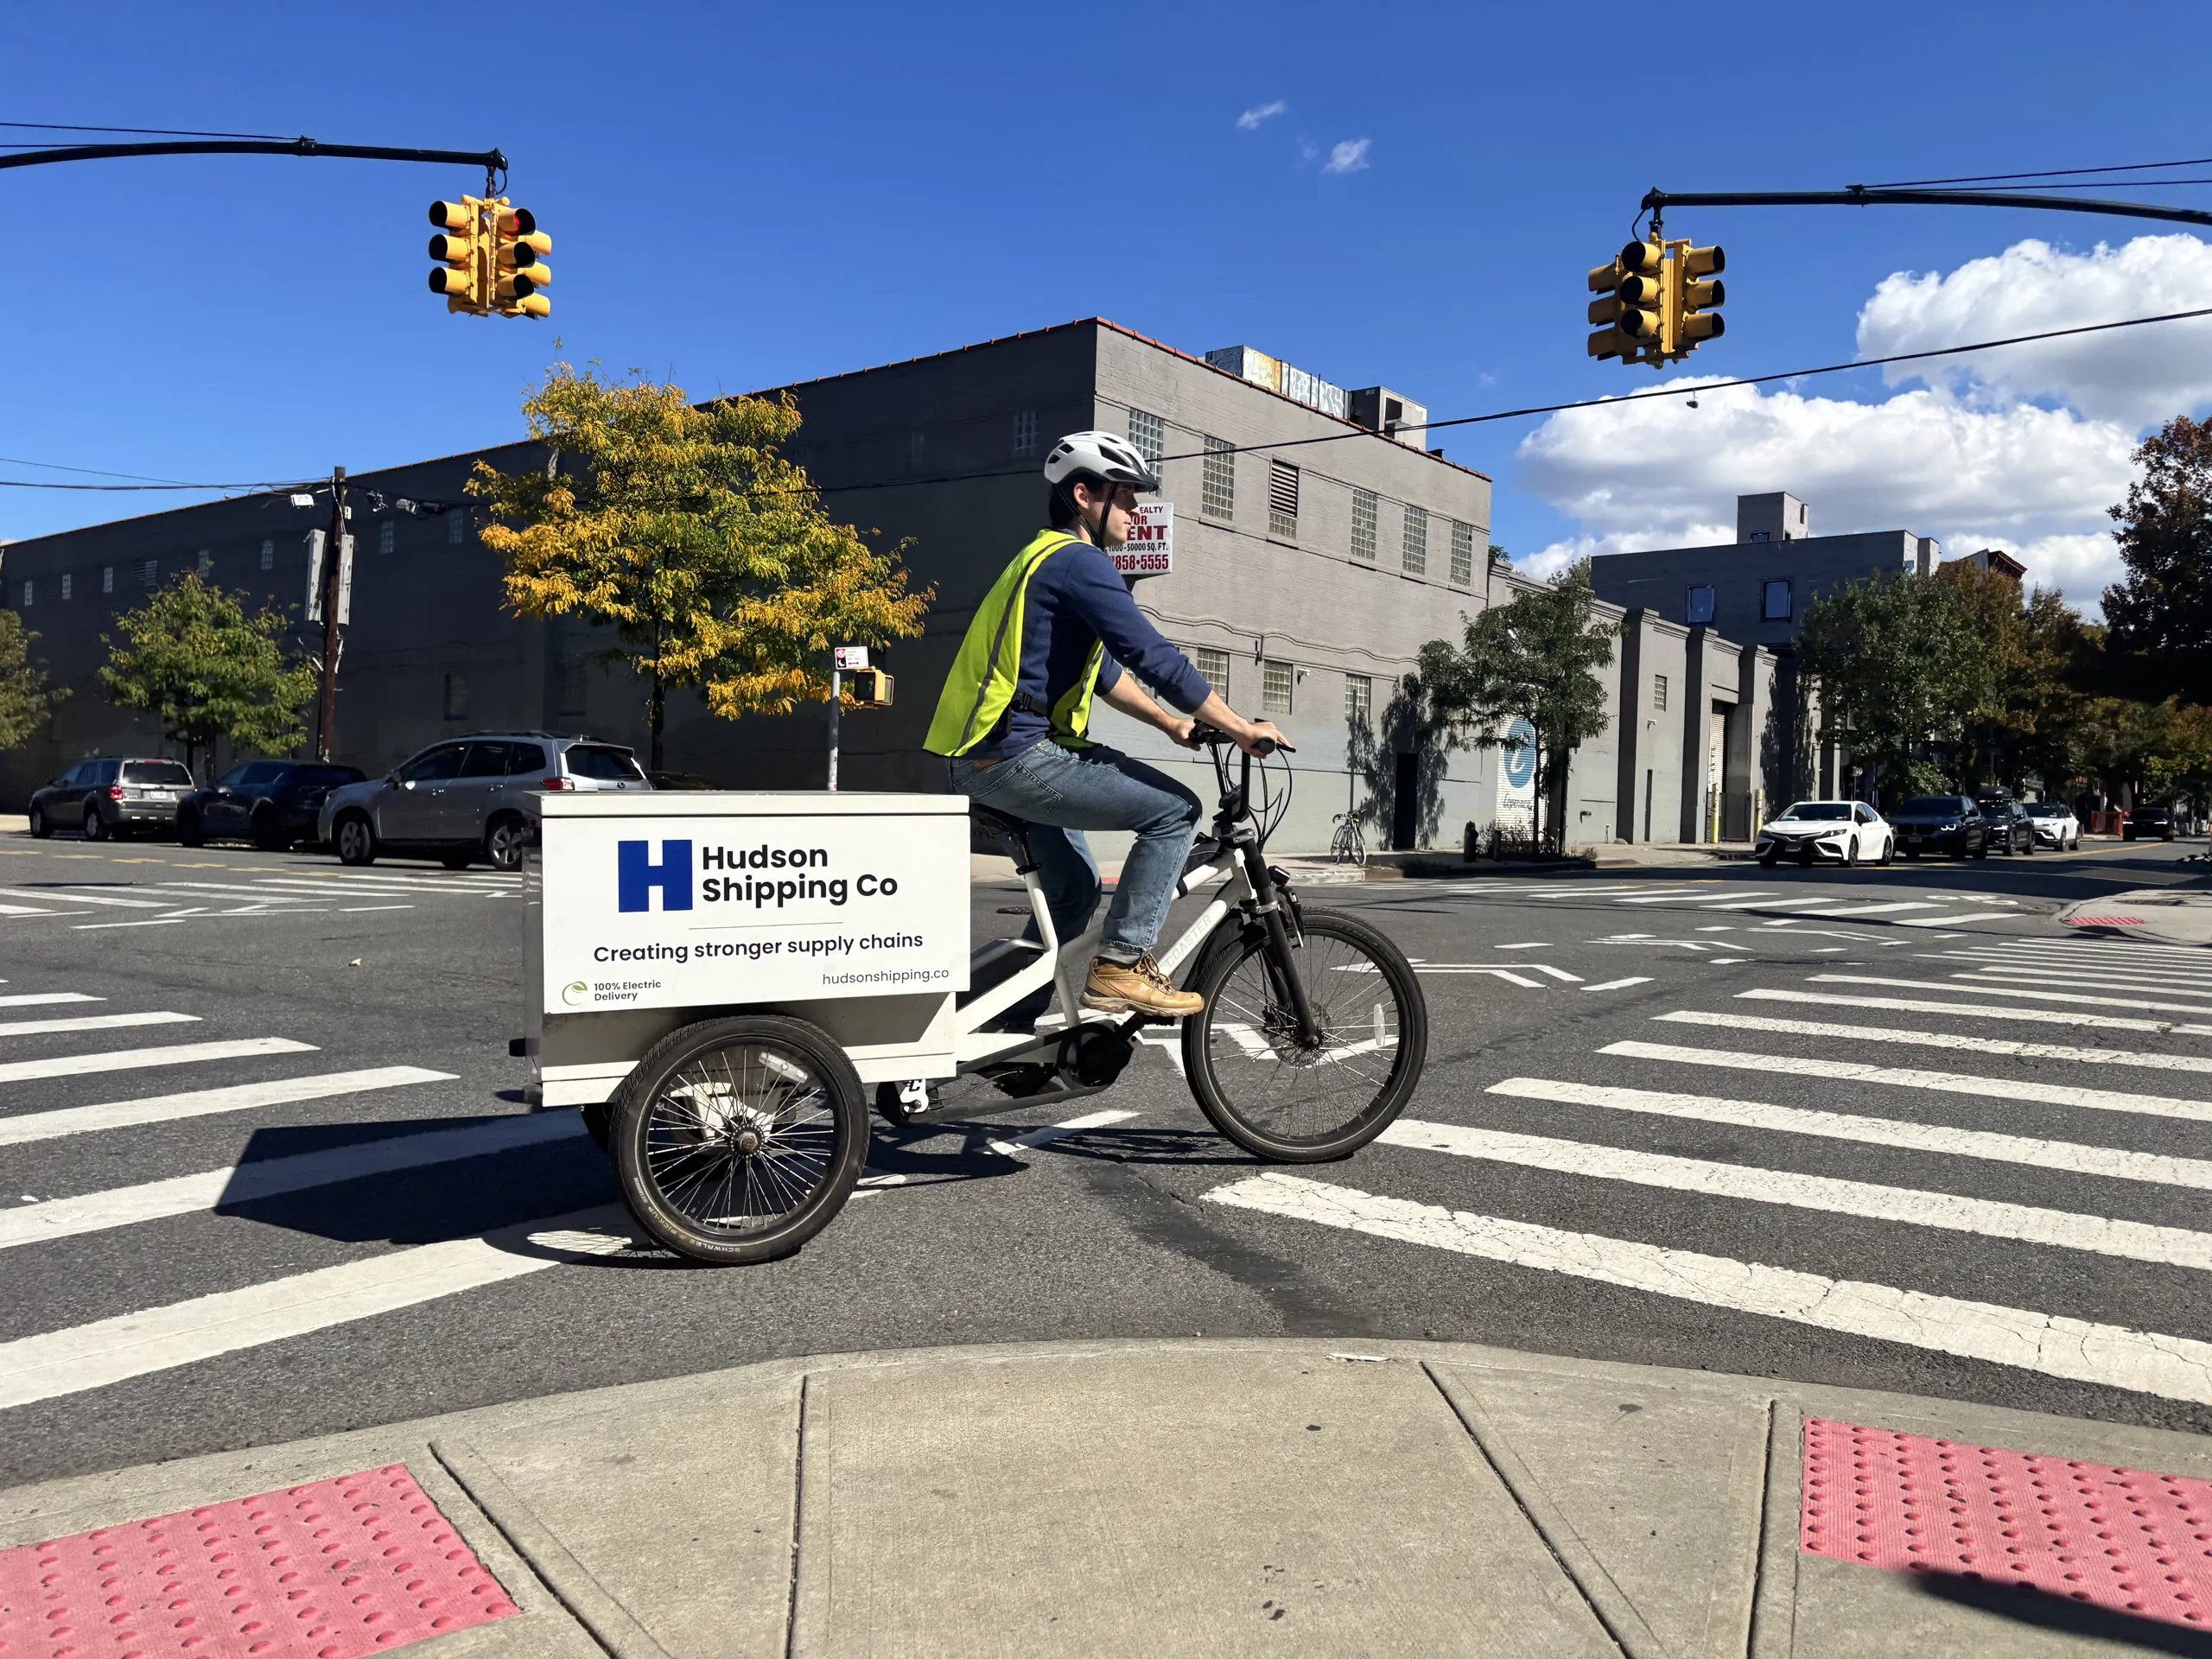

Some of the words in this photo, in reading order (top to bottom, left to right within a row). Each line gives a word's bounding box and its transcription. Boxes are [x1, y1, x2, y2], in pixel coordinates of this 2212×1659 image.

[1132, 516, 1147, 525] OR
[1127, 525, 1168, 540] ENT
[1127, 543, 1147, 551] 50000
[1147, 543, 1157, 552] SQ.
[1158, 543, 1168, 551] FT.
[702, 844, 828, 870] Hudson
[618, 840, 693, 913] H
[702, 874, 849, 908] Shipping
[856, 874, 899, 897] Co
[594, 943, 689, 963] Creating
[694, 939, 782, 960] stronger
[787, 934, 855, 957] supply
[859, 932, 924, 950] chains
[822, 968, 950, 986] hudsonshipping.co
[594, 982, 620, 991] 100%
[622, 980, 662, 990] Electric
[594, 990, 639, 1001] Delivery
